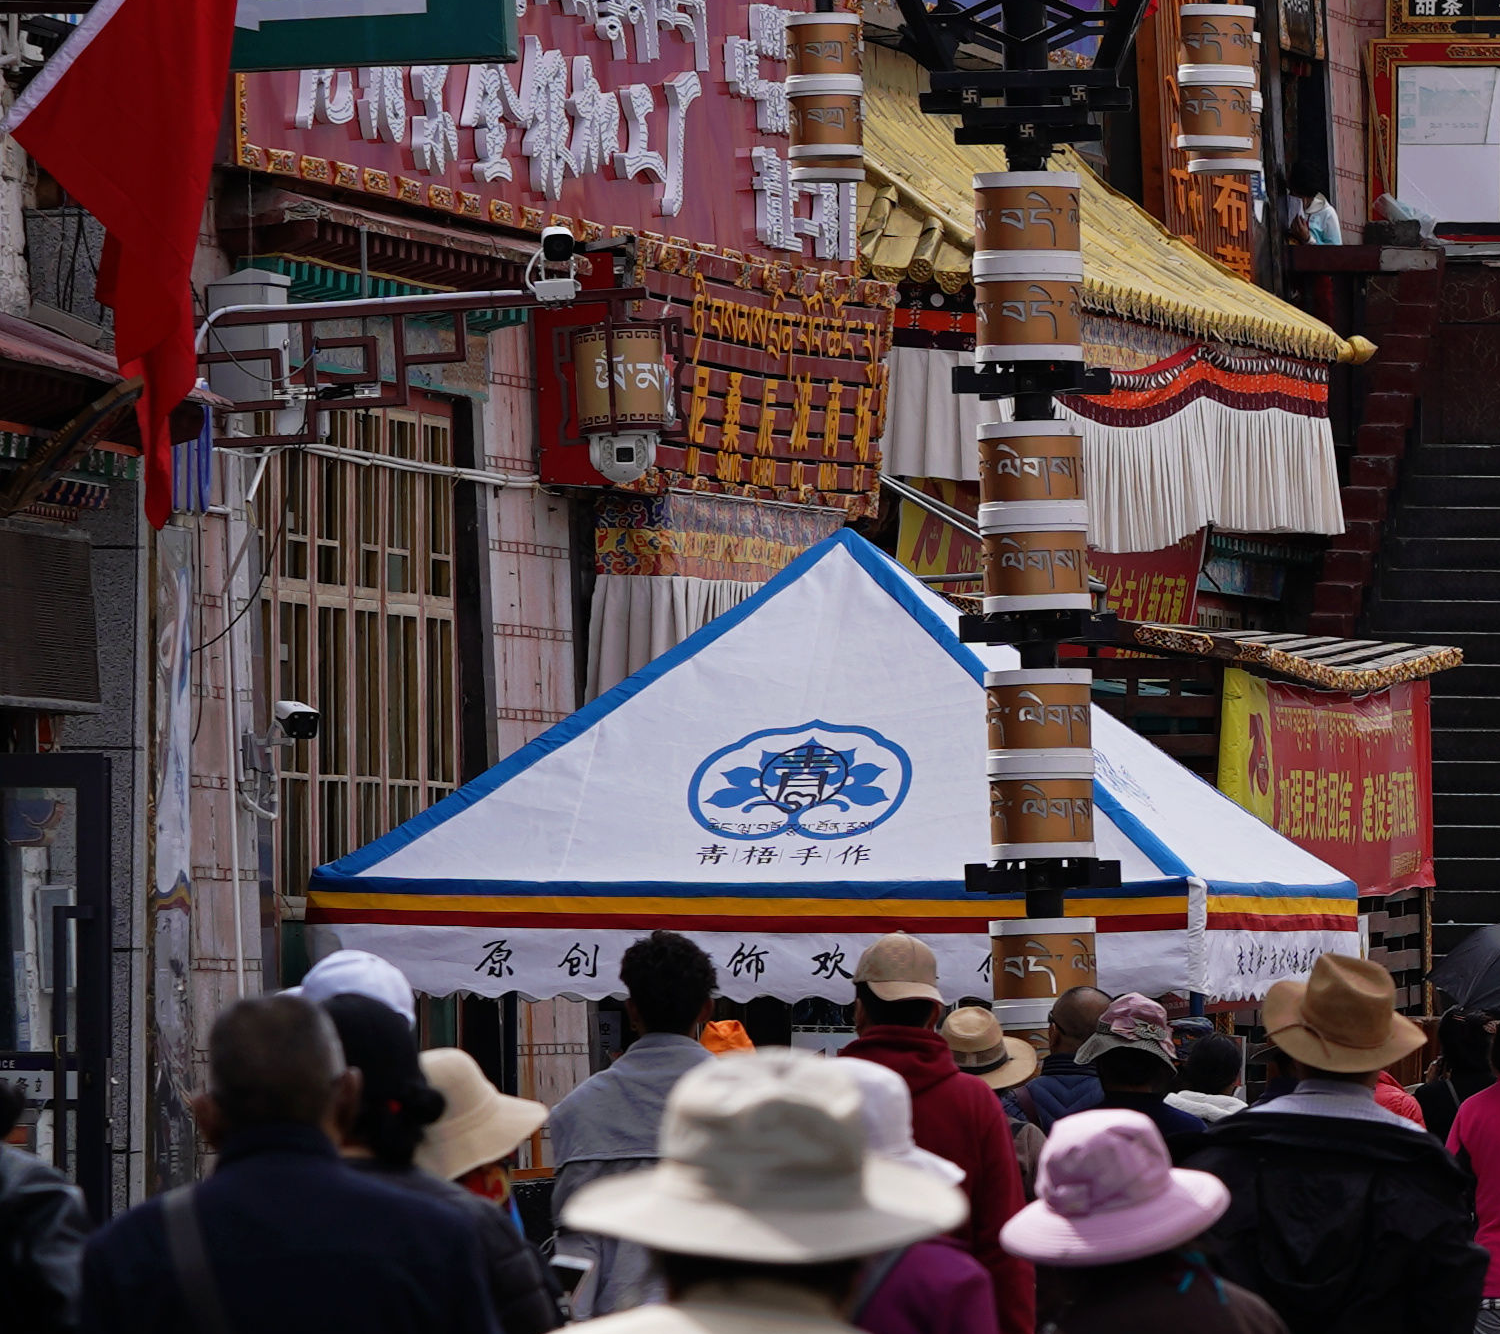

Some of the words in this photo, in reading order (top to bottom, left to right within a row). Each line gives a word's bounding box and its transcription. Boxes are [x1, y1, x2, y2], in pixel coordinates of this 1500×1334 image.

[688, 365, 873, 462] 尼桑辰波商场
